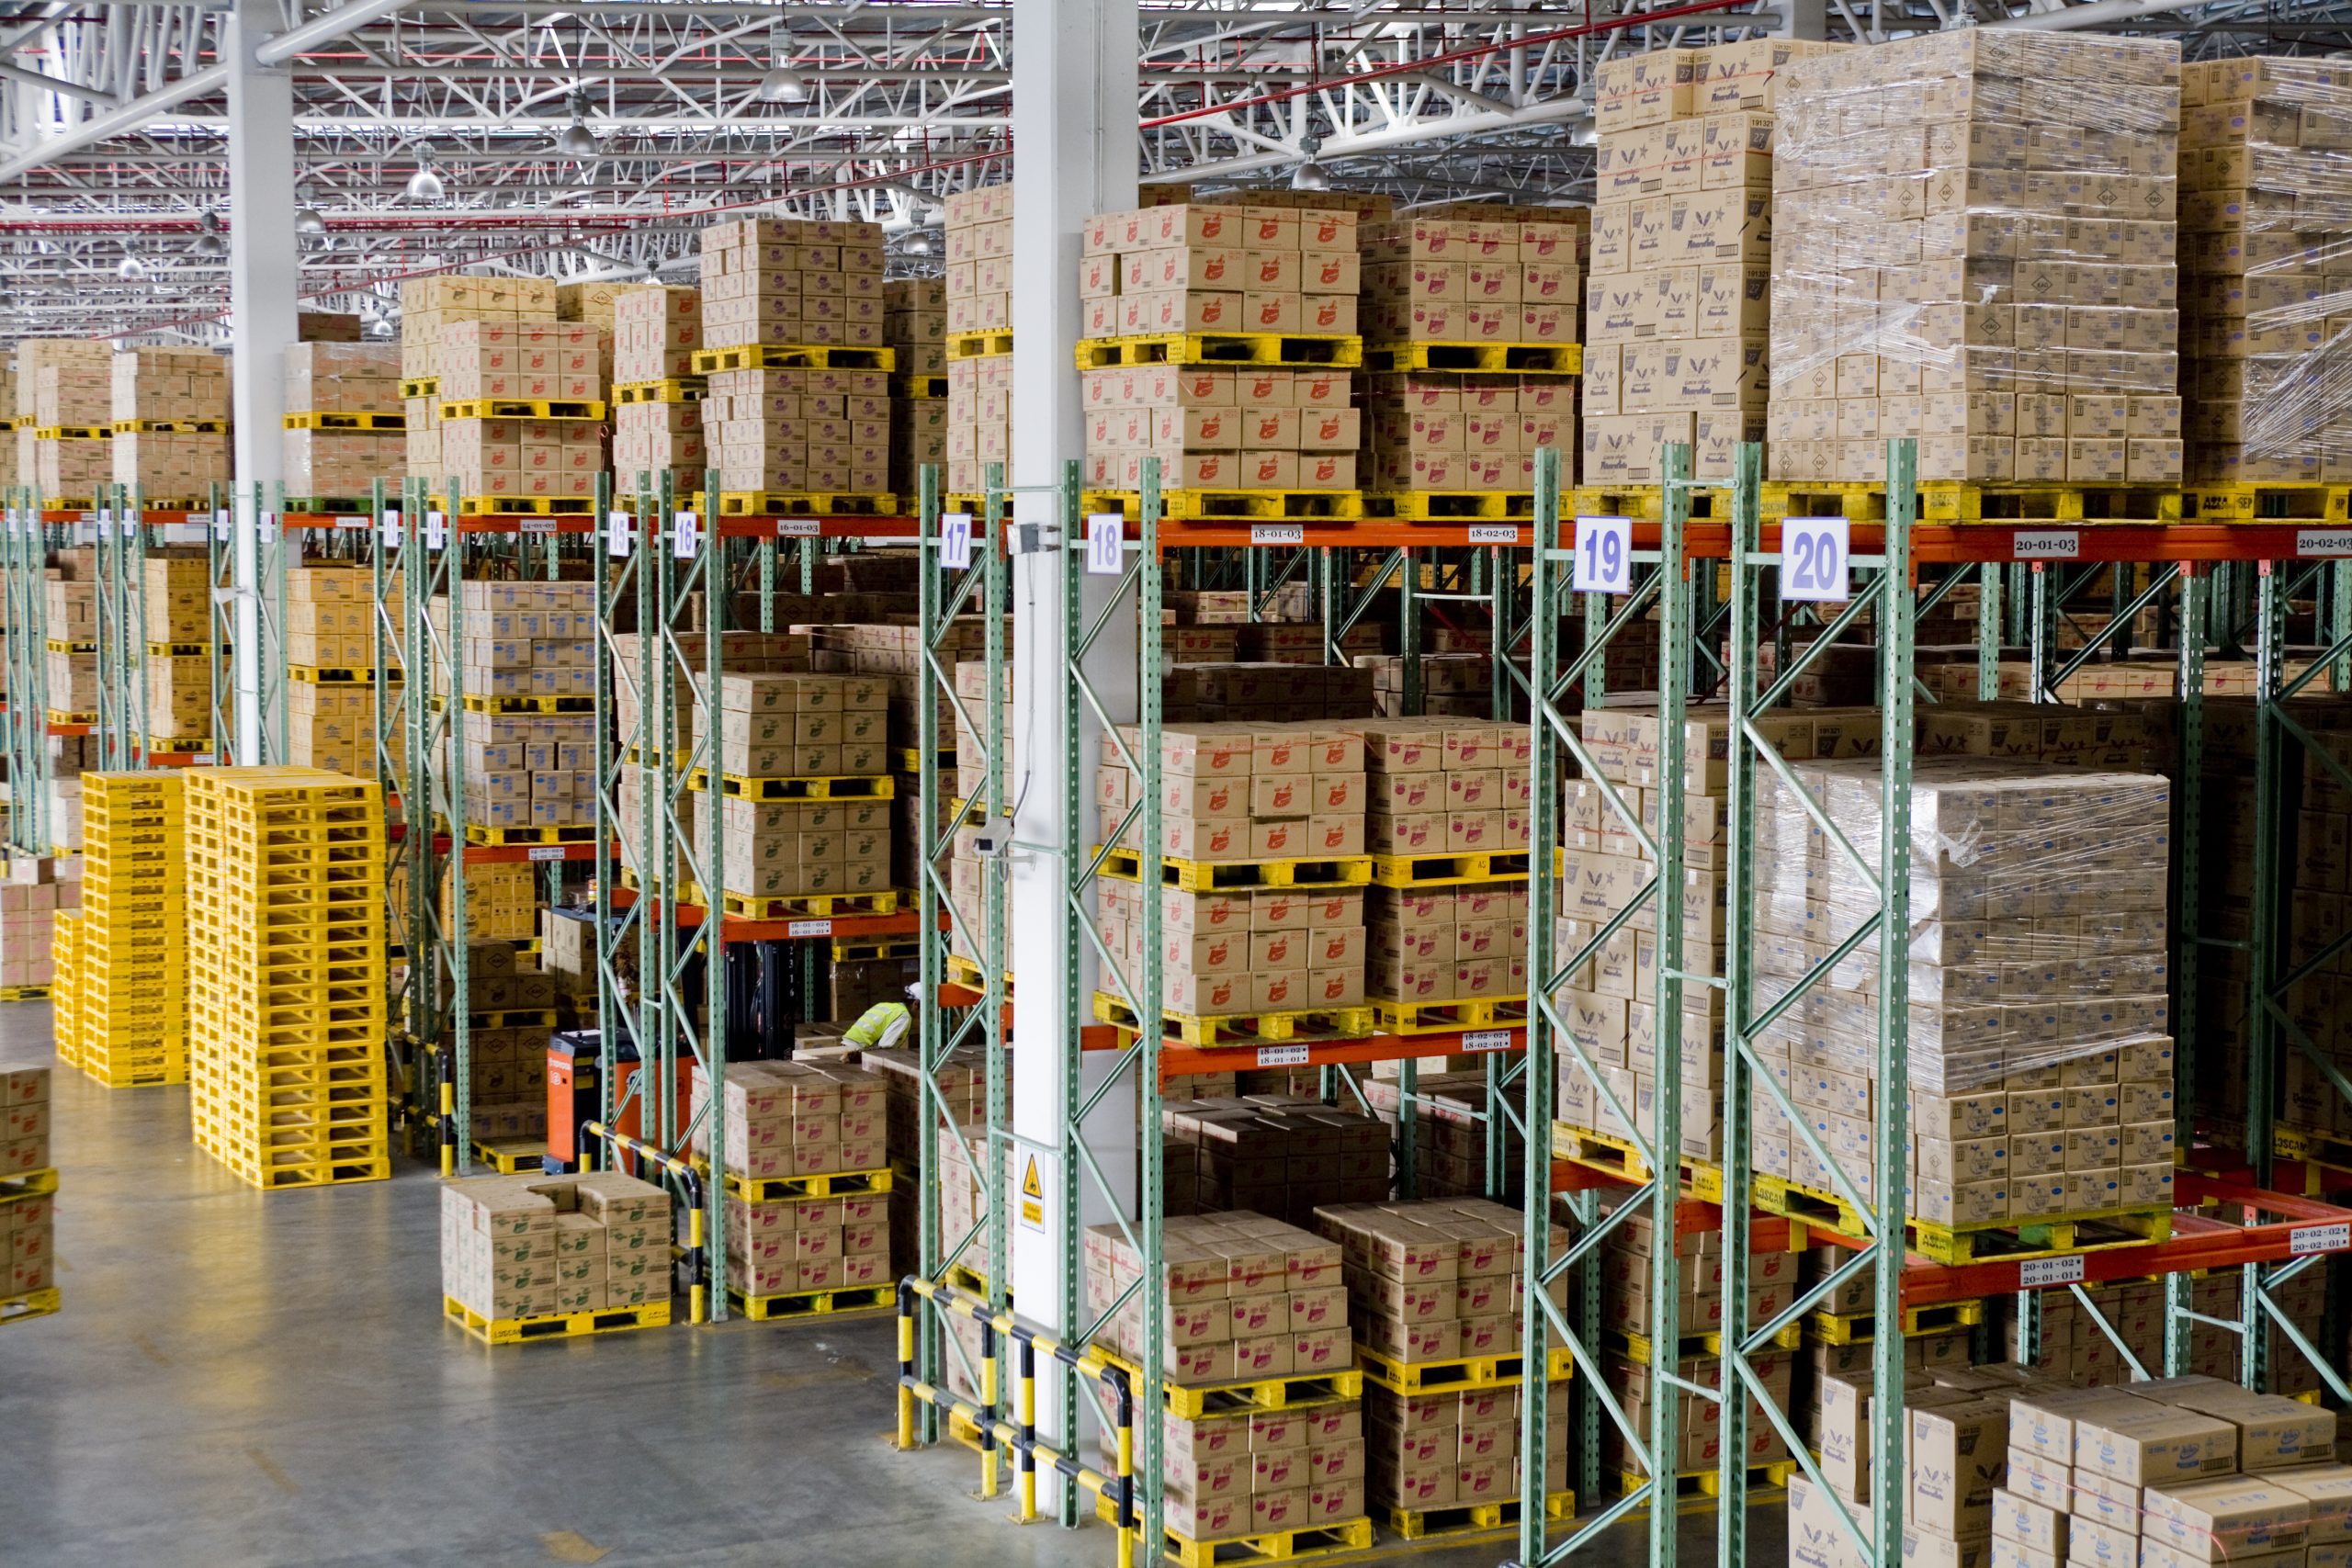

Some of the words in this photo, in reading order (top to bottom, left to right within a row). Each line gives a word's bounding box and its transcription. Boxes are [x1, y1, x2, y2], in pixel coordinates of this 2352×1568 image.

[1678, 54, 1694, 63] 19132
[1751, 118, 1773, 128] 191321
[1753, 132, 1765, 142] 27
[2238, 497, 2253, 509] SEP
[780, 524, 819, 532] 16-01-03
[1254, 528, 1301, 539] 18-01-03
[1472, 528, 1515, 539] 18-02-03
[613, 519, 625, 550] 15
[679, 519, 692, 551] 16
[947, 523, 966, 561] 17
[1094, 524, 1116, 567] 18
[2016, 539, 2075, 552] 20-01-03
[2299, 537, 2352, 550] 20-02-03
[1585, 529, 1621, 583] 19
[1792, 532, 1838, 590] 20
[1464, 1032, 1503, 1041] 18-02-02
[1260, 1047, 1301, 1055] 18-01-02
[1465, 1041, 1502, 1050] 18-02-01
[1261, 1056, 1300, 1065] 18-01-01
